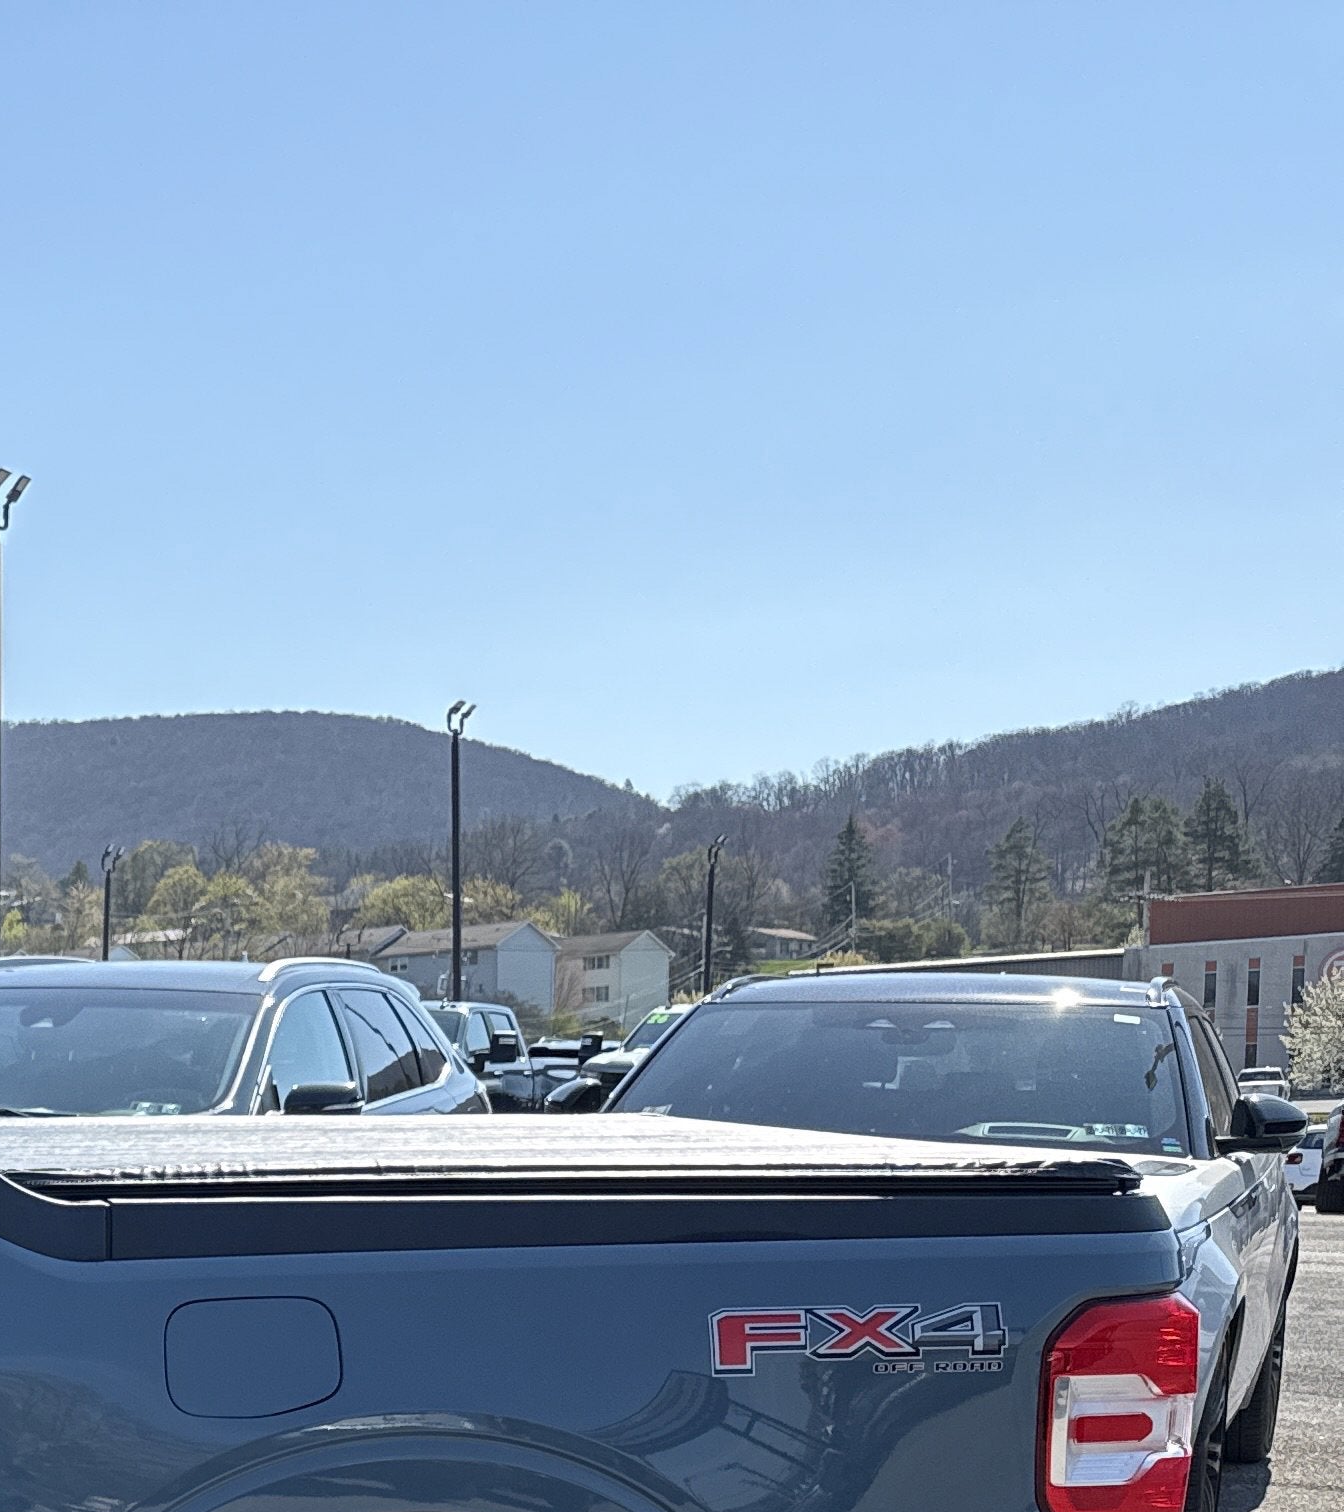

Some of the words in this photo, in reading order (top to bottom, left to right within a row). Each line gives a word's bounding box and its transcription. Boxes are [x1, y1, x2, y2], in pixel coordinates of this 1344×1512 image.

[708, 1302, 1008, 1377] FX4
[873, 1362, 925, 1374] OFF
[933, 1360, 1003, 1373] ROAD
